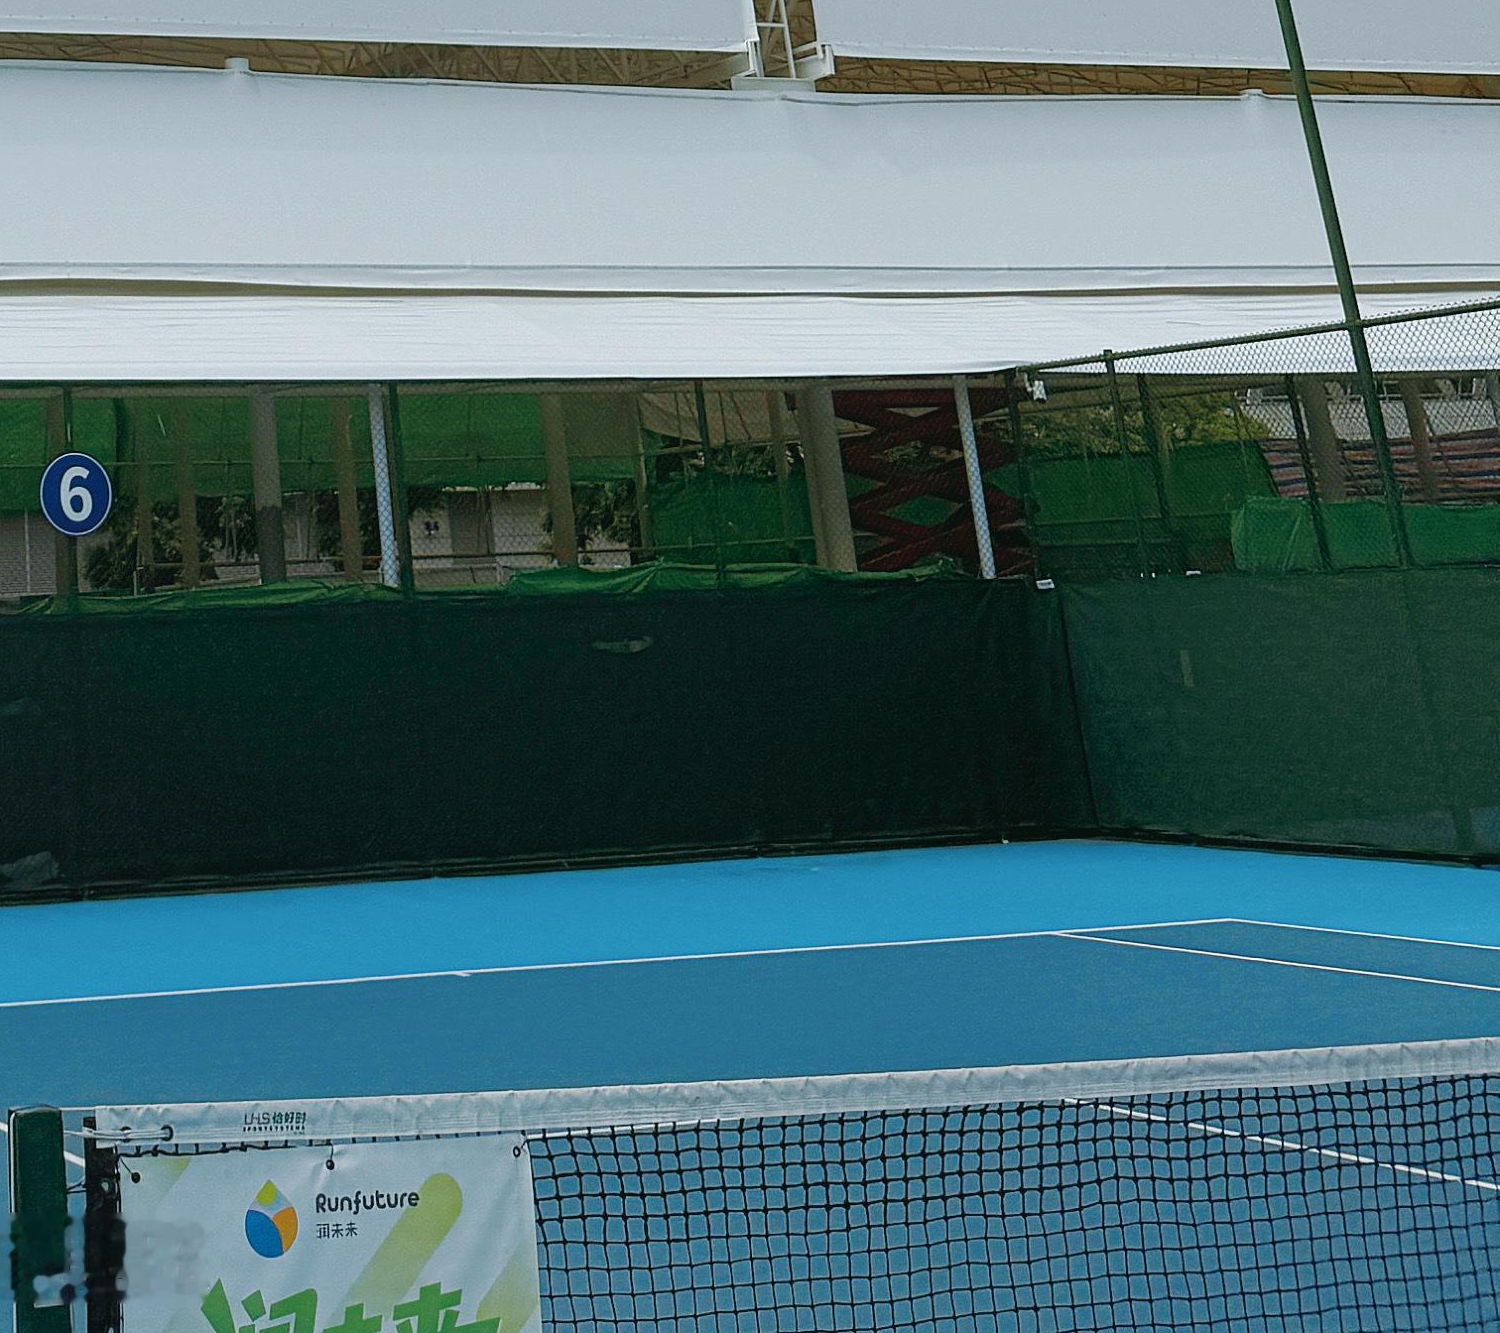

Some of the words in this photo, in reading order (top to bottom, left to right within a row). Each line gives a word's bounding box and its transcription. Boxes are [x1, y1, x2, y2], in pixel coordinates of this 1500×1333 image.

[60, 466, 93, 522] 6
[316, 1190, 420, 1215] Runfuture
[316, 1221, 358, 1239] 润未来
